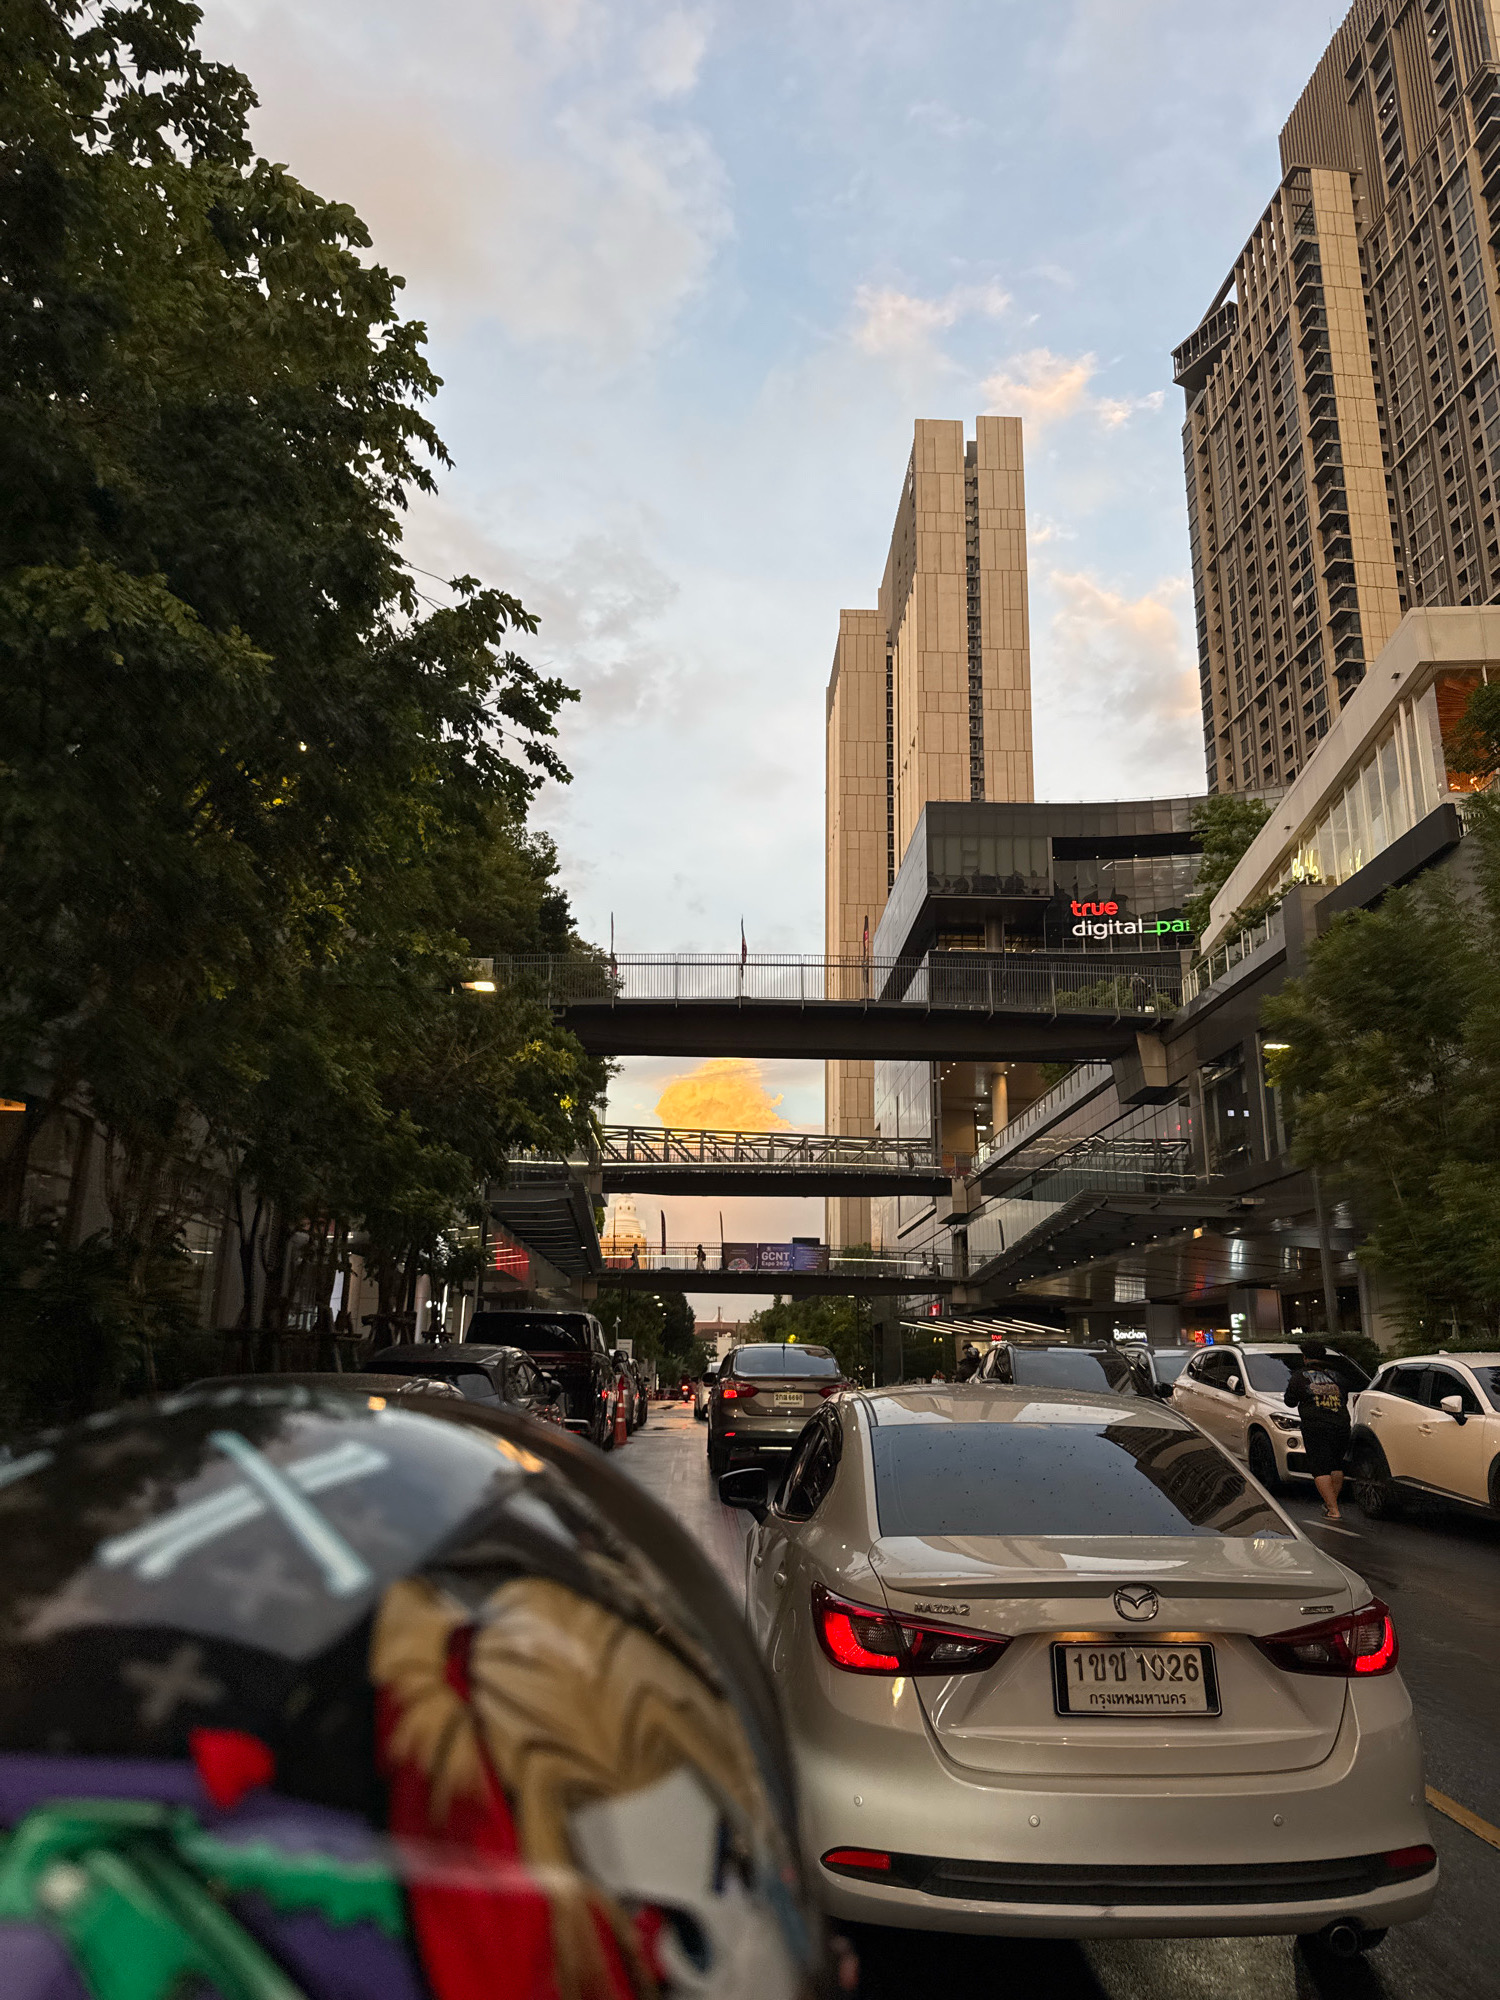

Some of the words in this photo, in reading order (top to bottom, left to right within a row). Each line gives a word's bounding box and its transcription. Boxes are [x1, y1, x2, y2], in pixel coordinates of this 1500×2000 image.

[1070, 900, 1118, 916] true
[1072, 918, 1143, 940] digital
[761, 1251, 790, 1261] GCNT
[914, 1602, 970, 1616] MAZDA2
[1136, 1652, 1200, 1682] 1026
[1089, 1692, 1187, 1709] กรุงเทพมหานคร
